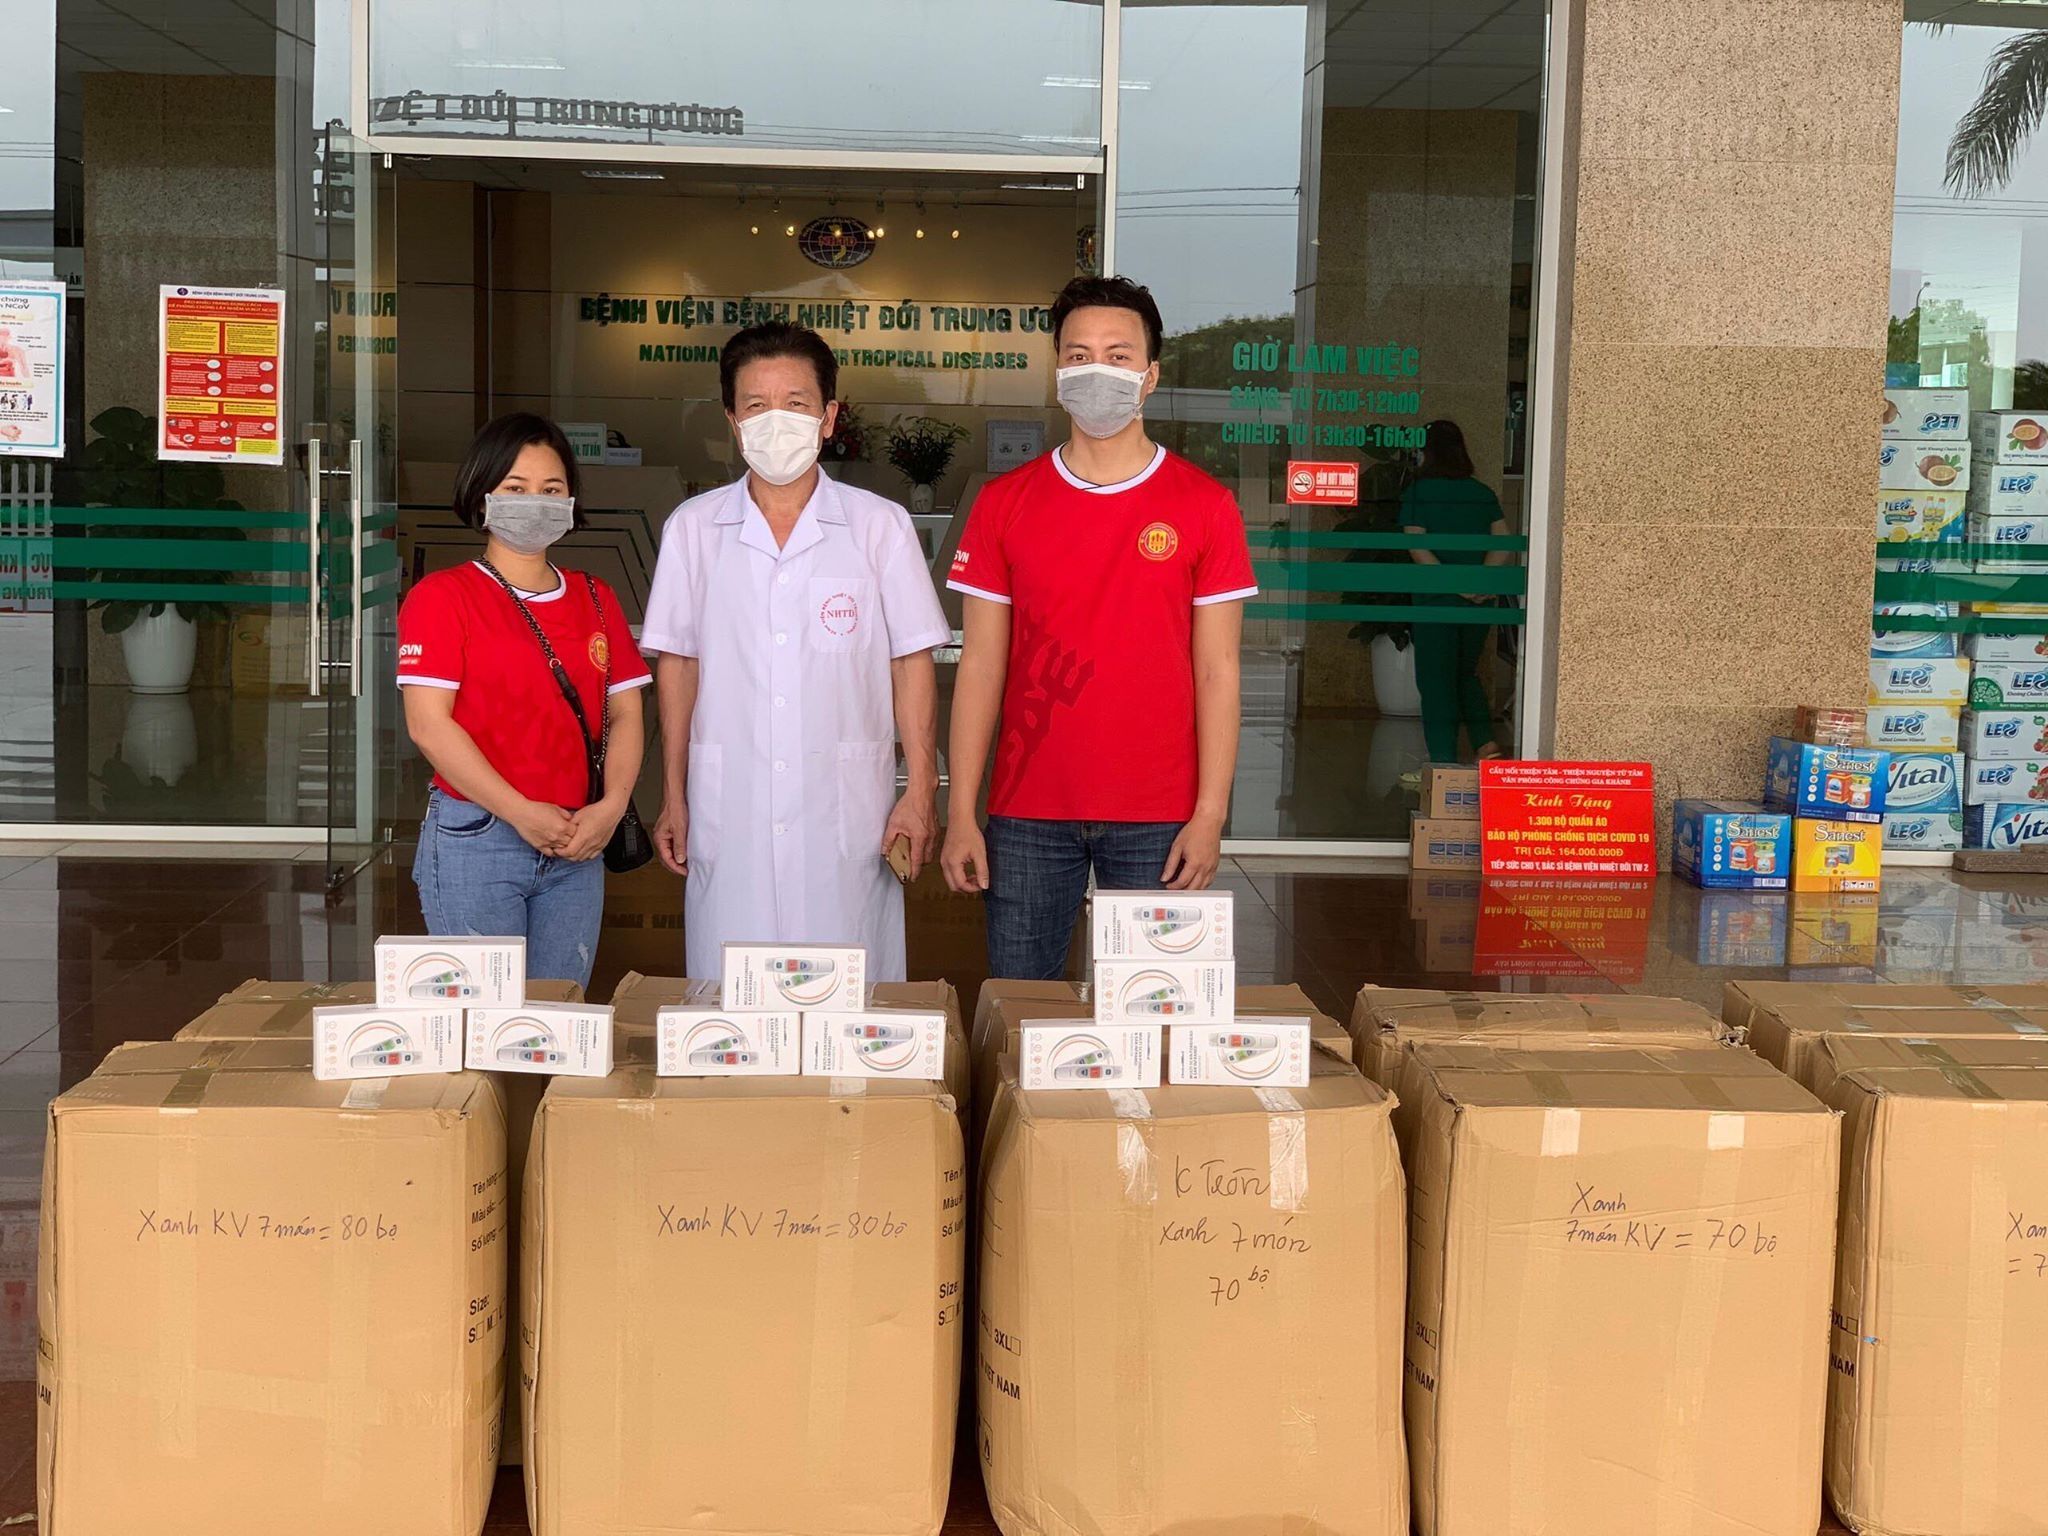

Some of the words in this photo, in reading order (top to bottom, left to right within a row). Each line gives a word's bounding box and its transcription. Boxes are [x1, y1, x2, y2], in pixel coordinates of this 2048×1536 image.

[530, 97, 642, 130] TRUNG
[580, 292, 647, 327] BỆNH
[655, 295, 715, 329] VIỆN
[722, 296, 791, 328] BỆNH
[797, 299, 869, 334] NHIỆT
[878, 299, 921, 332] ĐỚI
[930, 305, 1012, 332] TRUNG
[1019, 305, 1056, 333] ƯƠ
[639, 344, 721, 363] NATIONA
[851, 349, 936, 368] TROPICAL
[942, 351, 1028, 369] DISEASES
[1233, 335, 1281, 372] GIỜ
[1356, 341, 1420, 382] VIỆC
[827, 609, 855, 618] NHTD
[1890, 664, 1937, 688] LEO
[1883, 711, 1929, 736] LEO
[1542, 767, 1558, 776] TÂM
[1628, 769, 1643, 777] TÂM
[1977, 764, 2017, 784] LEO
[1528, 816, 1552, 827] 1.300
[1554, 816, 1566, 828] BỘ
[1595, 815, 1608, 827] ÁO
[1507, 829, 1520, 843] HỘ
[1522, 830, 1553, 842] PHÒNG
[1554, 829, 1585, 843] CHỐNG
[1587, 832, 1608, 844] DỊCH
[1610, 833, 1637, 843] COVID
[1639, 833, 1650, 843] 19
[1514, 846, 1532, 857] TRỊ
[1534, 846, 1556, 856] GIÁ:
[1558, 847, 1624, 857] 164.000.000Đ
[1643, 863, 1649, 872] 2
[472, 1180, 486, 1196] Tên
[1571, 1181, 1627, 1214] Xanh
[137, 1208, 199, 1241] Xanh
[213, 1208, 250, 1238] KV
[342, 1214, 368, 1240] 80
[471, 1208, 486, 1225] Màu
[658, 1204, 712, 1237] Xanh
[720, 1203, 763, 1237] KV
[848, 1211, 879, 1239] 80
[941, 1220, 953, 1238] Số
[471, 1234, 483, 1252] Số
[1706, 1218, 1746, 1250] 70
[1209, 1276, 1241, 1307] 70
[1247, 1265, 1270, 1290] bộ
[938, 1310, 945, 1327] S
[468, 1327, 476, 1344] S
[994, 1327, 1012, 1352] 3XL
[1415, 1320, 1430, 1345] 3XL
[1831, 1352, 1855, 1378] NAM
[996, 1373, 1021, 1401] NAM
[1415, 1366, 1435, 1393] NAM
